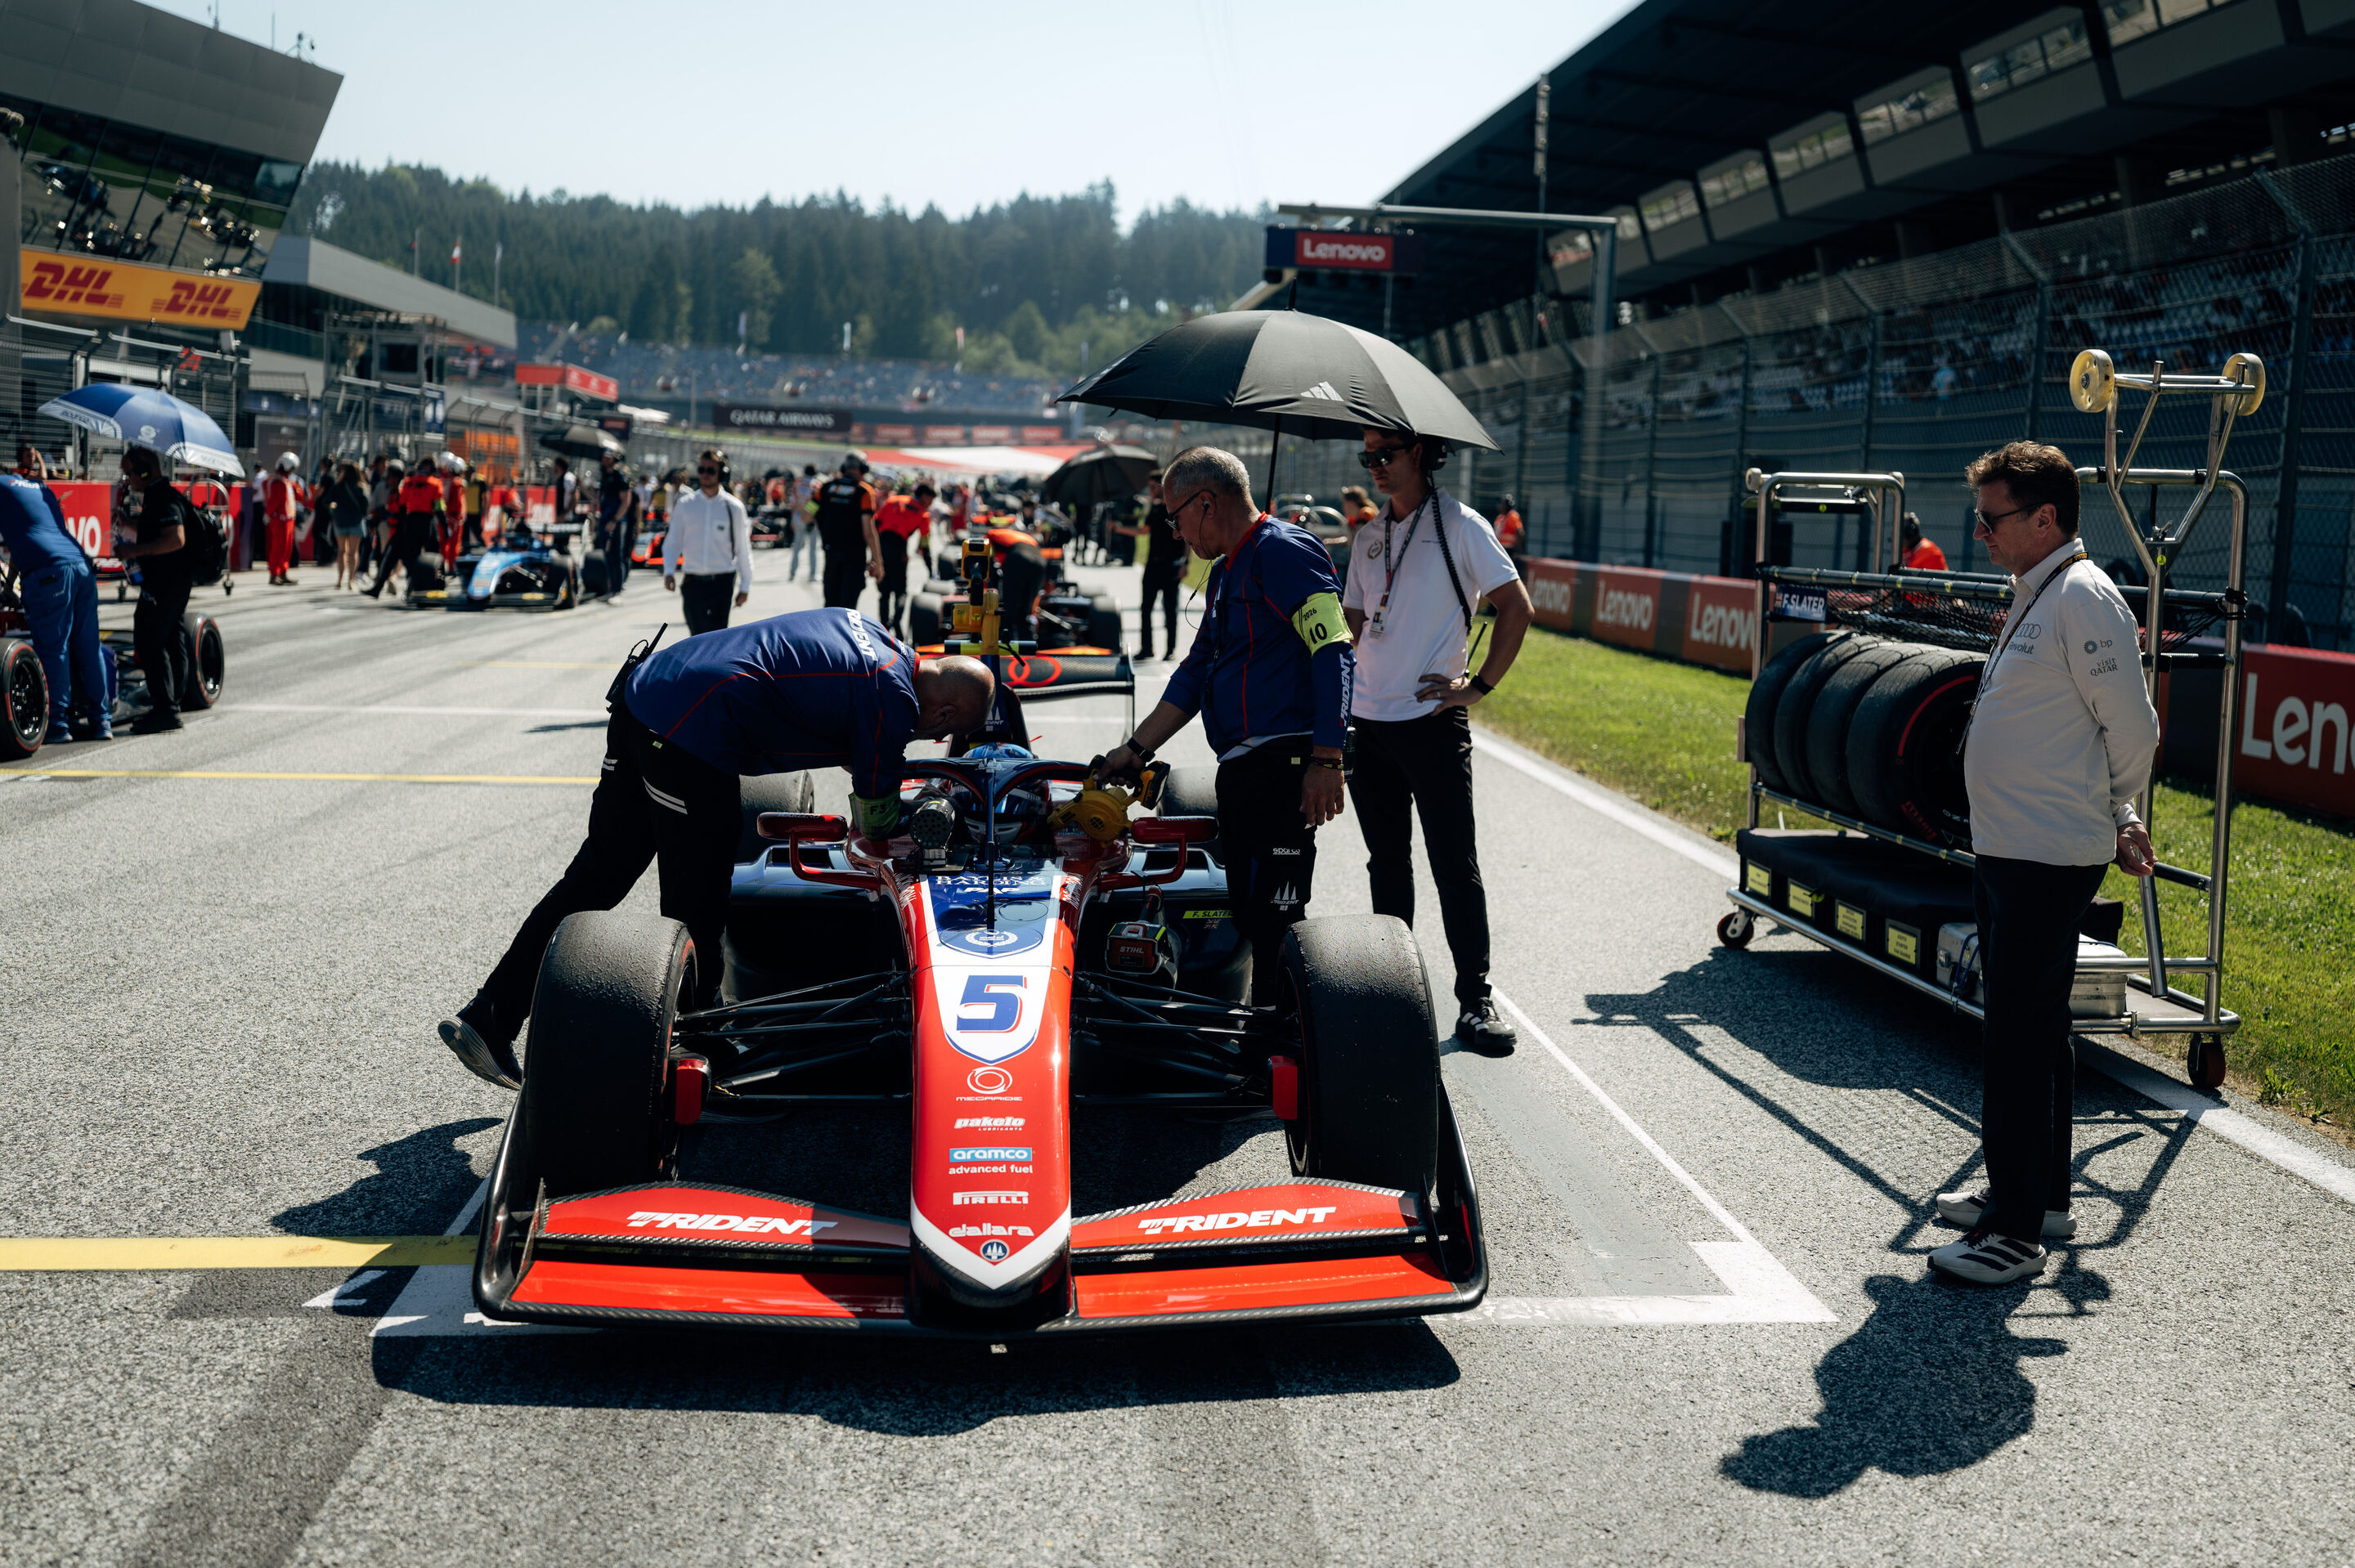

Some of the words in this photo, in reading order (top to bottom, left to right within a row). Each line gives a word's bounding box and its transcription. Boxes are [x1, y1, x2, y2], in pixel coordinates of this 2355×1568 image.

[1303, 238, 1386, 262] Lenovo
[25, 261, 113, 305] DHL
[164, 280, 234, 318] DHL
[729, 410, 777, 426] QATAR
[778, 411, 836, 429] AIRWAYS
[1527, 570, 1572, 615] Lenovo
[1595, 579, 1653, 632] Lenovo
[1783, 593, 1825, 614] F.SLATER
[1303, 607, 1317, 621] 2026
[1689, 591, 1757, 652] Lenov
[846, 607, 878, 661] RIDENT
[1309, 622, 1327, 644] 10
[2100, 639, 2113, 649] bp
[2090, 665, 2119, 677] QATAR
[2097, 657, 2116, 668] visit
[2241, 672, 2355, 775] Len
[870, 804, 886, 816] F3
[1272, 847, 1301, 856] sparco
[1119, 946, 1144, 954] STIHL
[956, 974, 1028, 1034] 5
[953, 1116, 1026, 1130] pakelo
[953, 1149, 1028, 1160] aramco
[949, 1164, 1007, 1175] advanced
[1010, 1164, 1034, 1174] fuel
[953, 1190, 1029, 1206] PIRELLI
[626, 1211, 839, 1236] TRIDENT
[949, 1222, 1035, 1238] dallara
[1137, 1206, 1337, 1234] TRIDENT
